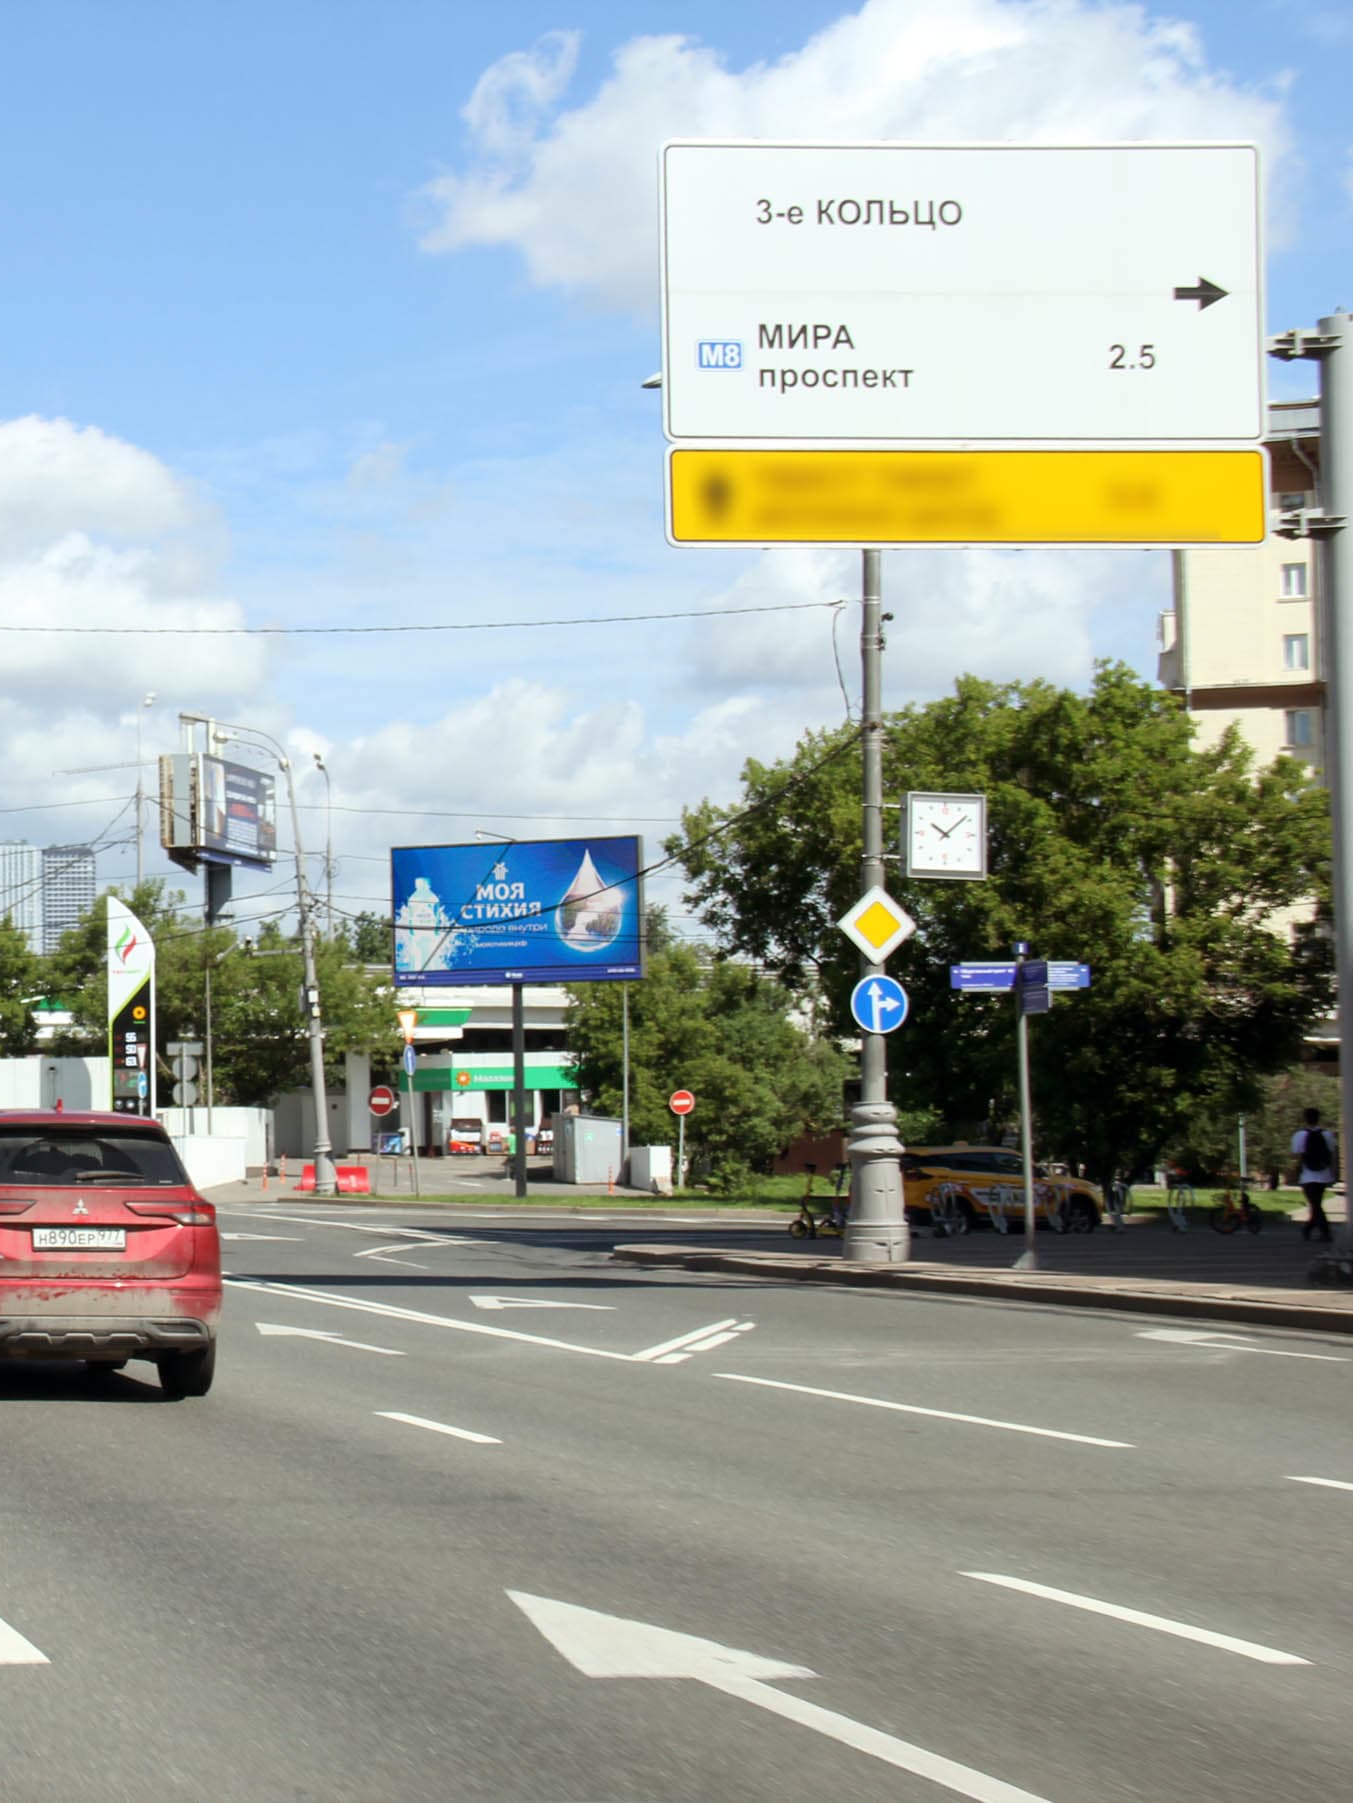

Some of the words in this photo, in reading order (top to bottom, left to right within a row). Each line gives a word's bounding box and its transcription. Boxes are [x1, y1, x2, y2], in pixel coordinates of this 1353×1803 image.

[757, 199, 803, 225] 3-е
[816, 199, 963, 230] КОЛЬЦО
[758, 323, 855, 350] МИРА
[1109, 344, 1156, 370] 2.5
[759, 368, 914, 394] проспект
[475, 882, 525, 901] МОЯ
[460, 901, 542, 919] СТИХИЯ
